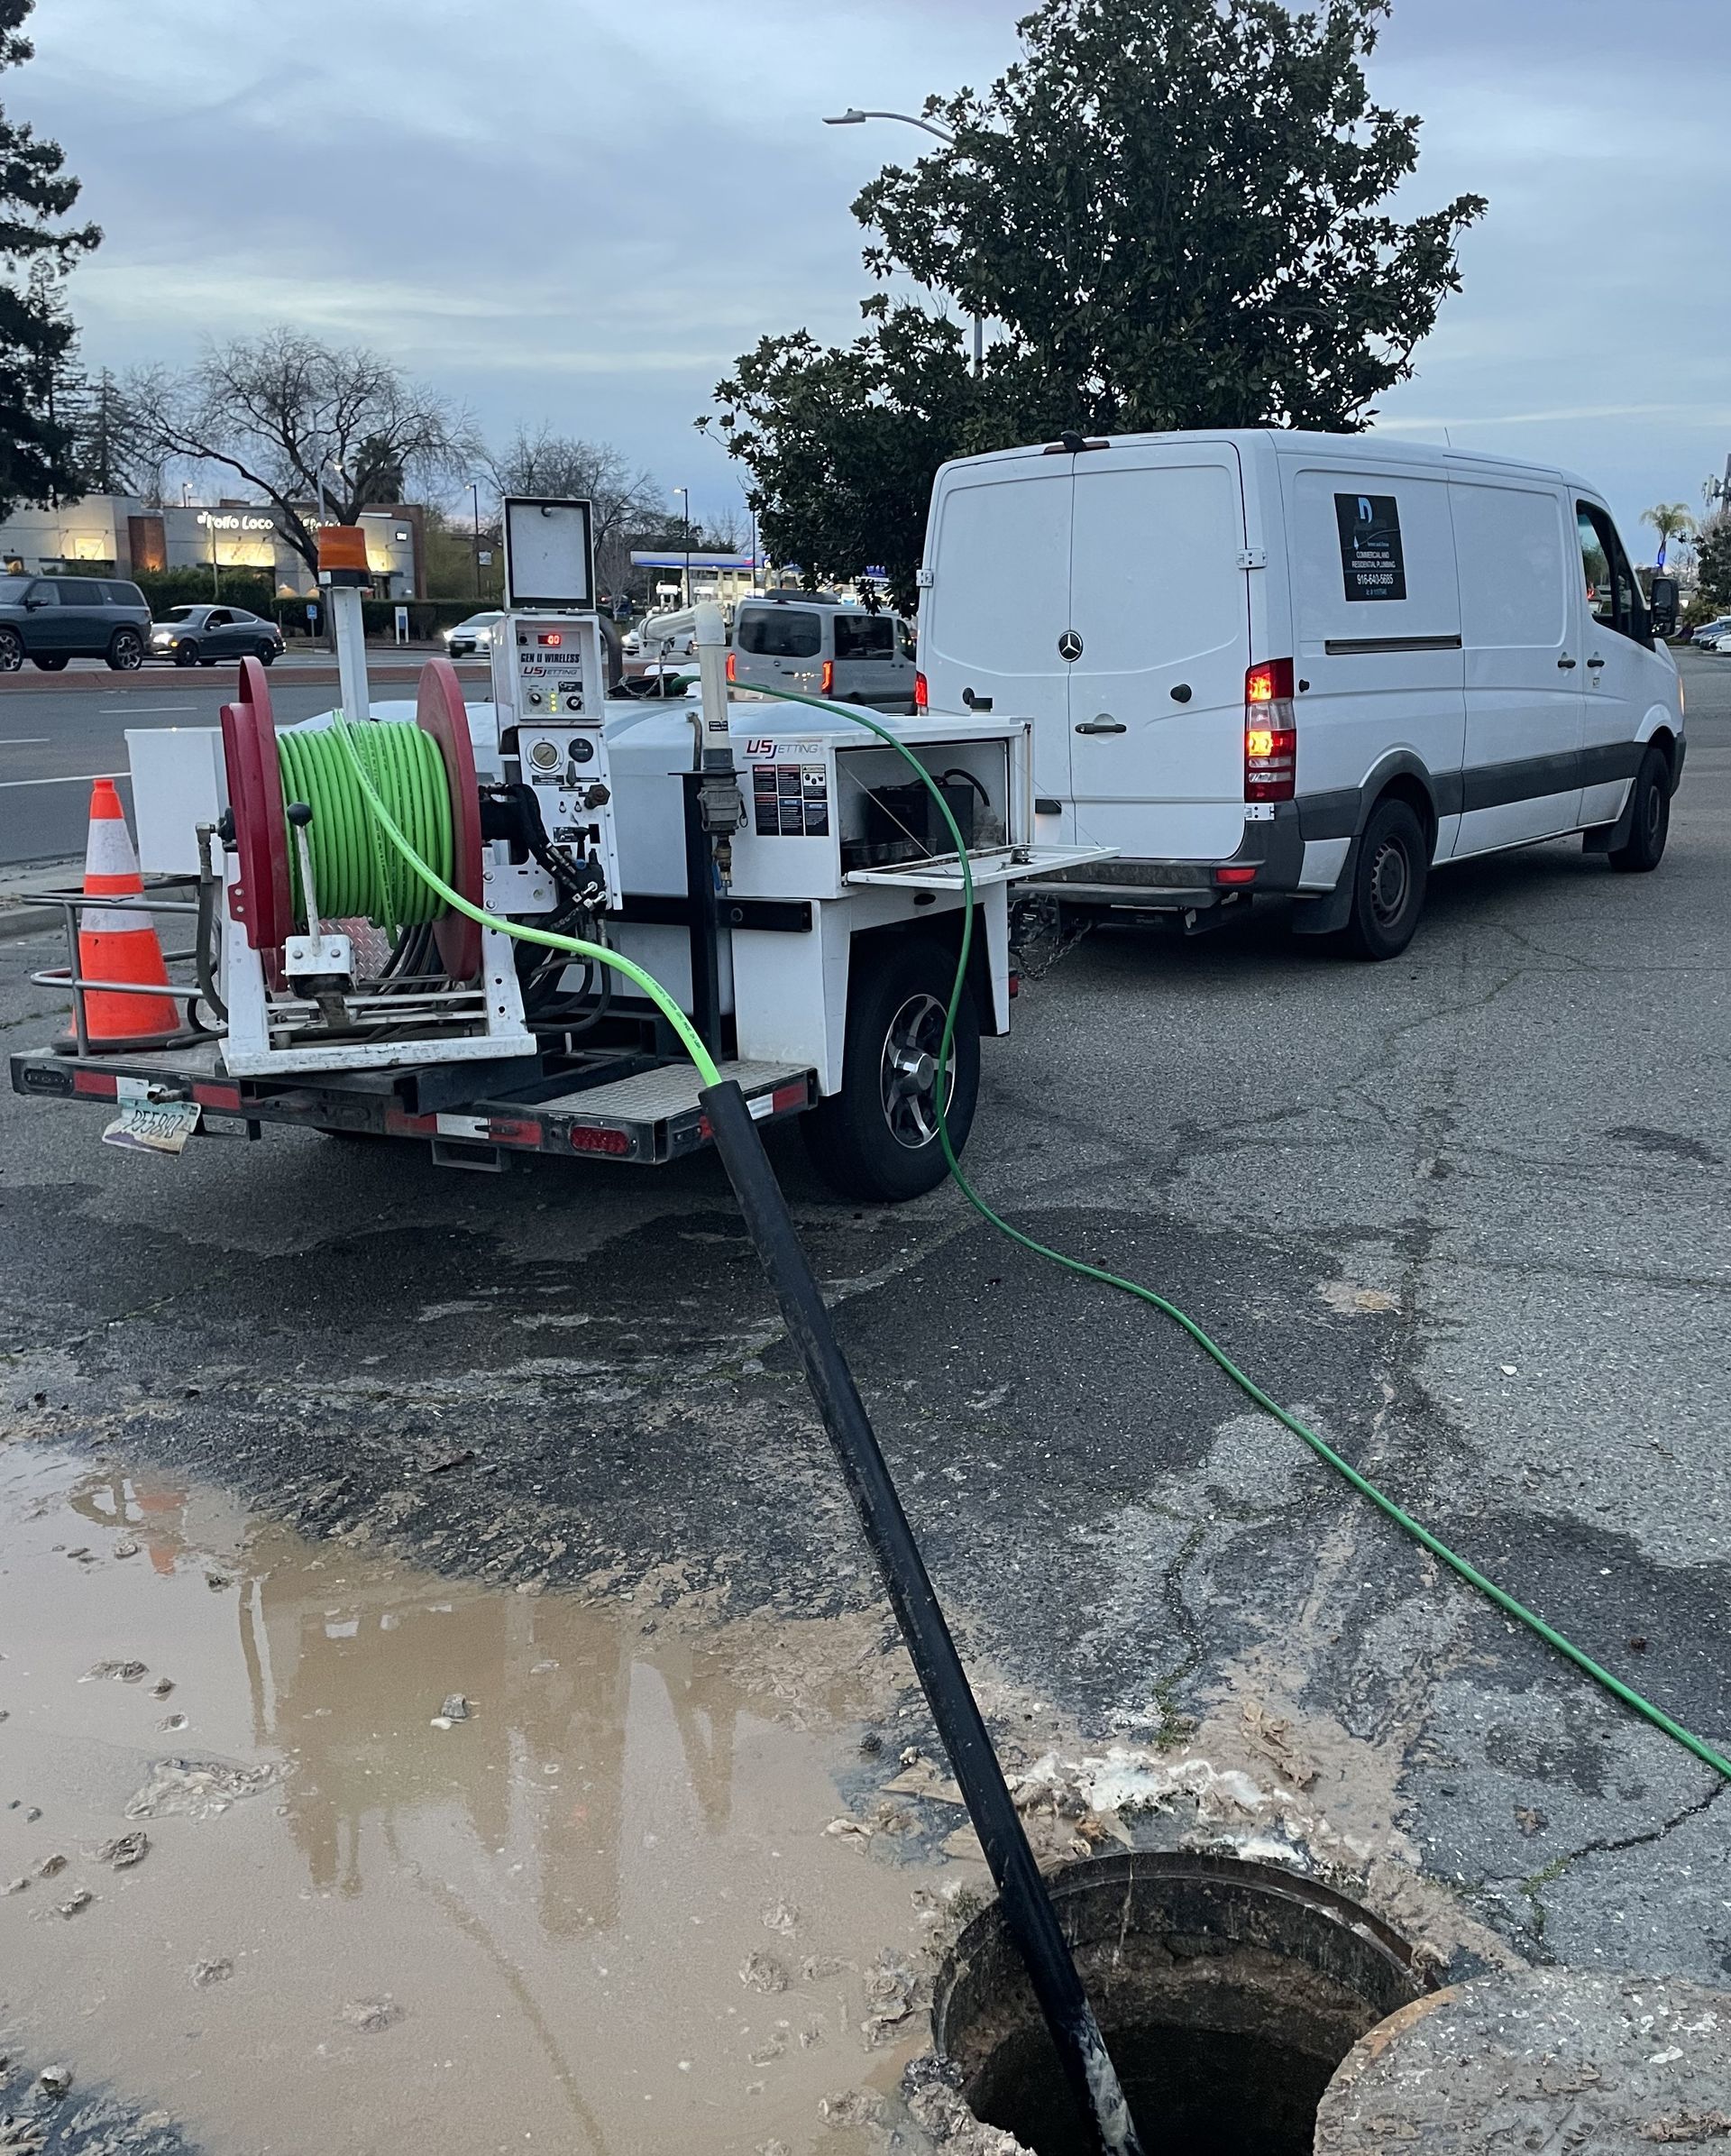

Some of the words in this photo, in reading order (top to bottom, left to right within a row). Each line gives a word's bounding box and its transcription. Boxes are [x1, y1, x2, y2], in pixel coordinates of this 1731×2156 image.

[242, 515, 274, 530] Loco
[520, 653, 535, 663] GEN
[545, 654, 580, 664] WIRELESS
